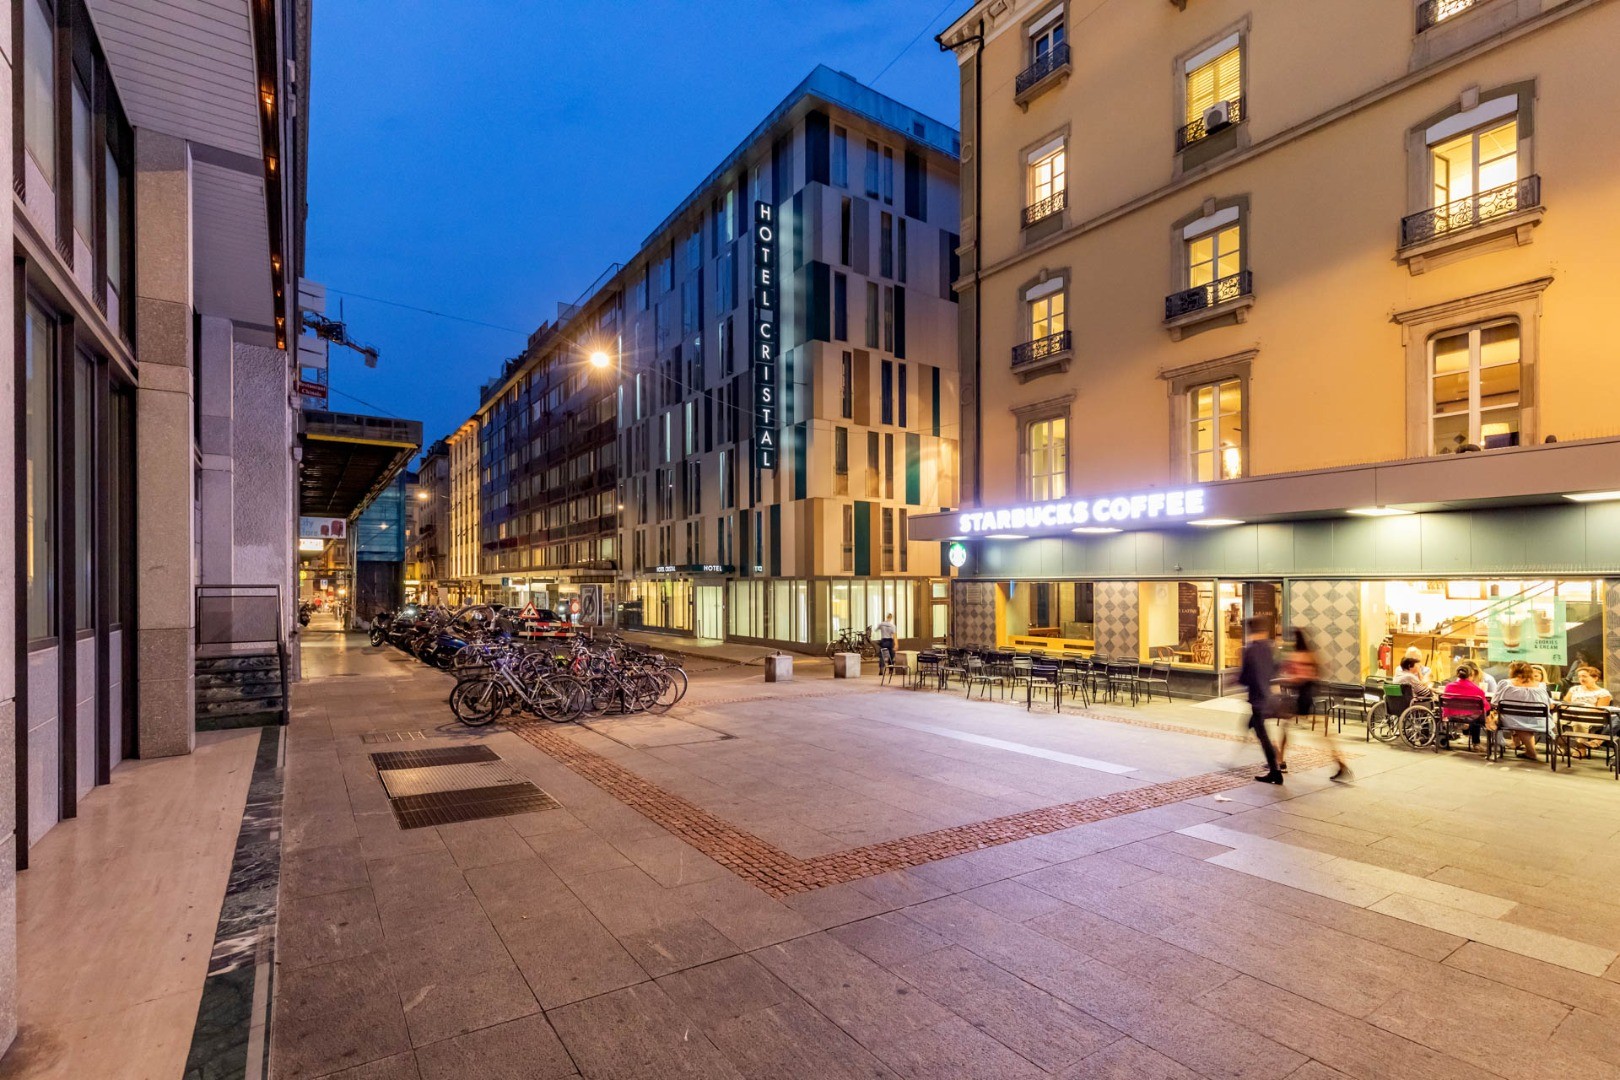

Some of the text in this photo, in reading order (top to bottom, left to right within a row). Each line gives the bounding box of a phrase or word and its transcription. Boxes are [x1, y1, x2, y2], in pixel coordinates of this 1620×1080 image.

[759, 204, 773, 467] HOTEL CRISTAL
[959, 490, 1204, 533] STARBUCKS COFFEE
